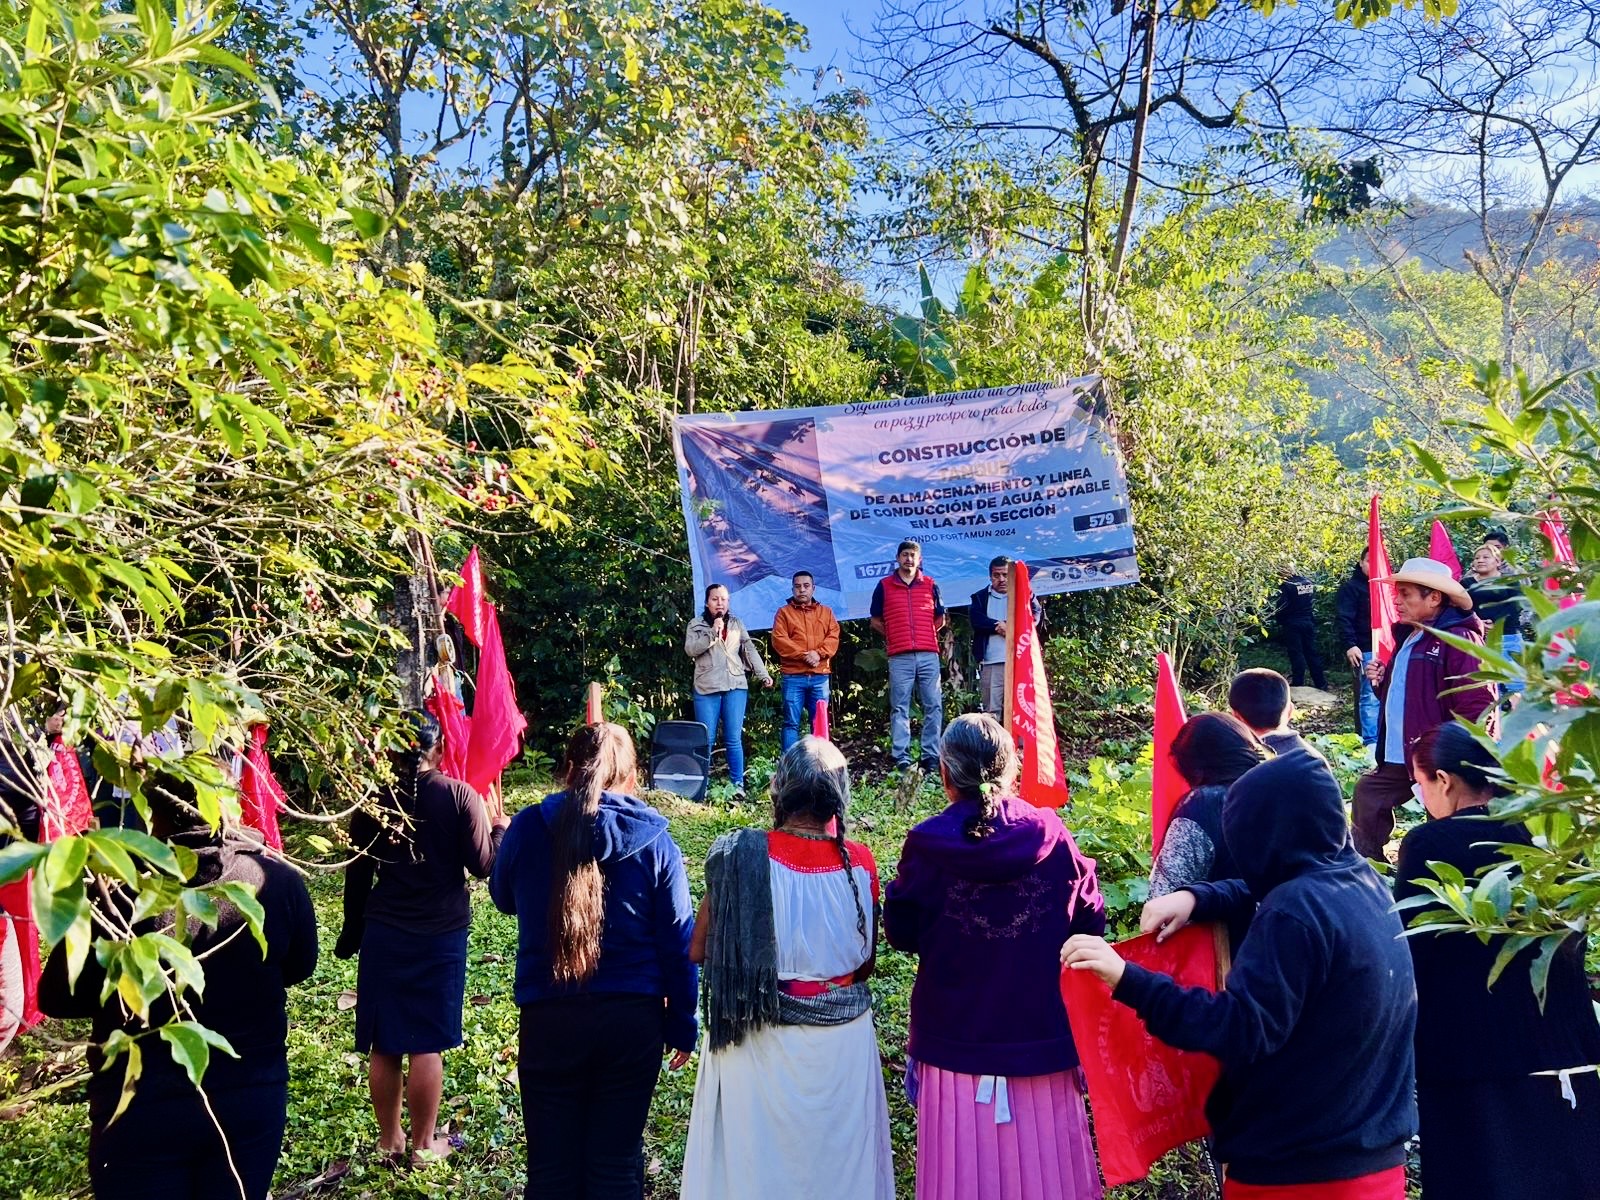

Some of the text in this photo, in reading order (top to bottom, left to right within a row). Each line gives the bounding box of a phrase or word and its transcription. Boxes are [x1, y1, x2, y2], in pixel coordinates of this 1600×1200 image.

[988, 387, 1003, 397] un
[874, 419, 890, 429] en
[889, 416, 914, 432] paz
[925, 409, 980, 428] prospero
[981, 404, 1014, 421] para
[1016, 398, 1048, 413] todos
[878, 427, 1066, 465] CONSTRUCCIÓN DE
[939, 460, 1012, 481] TANQUE
[864, 467, 1092, 506] DE ALMACENAMIENTO Y LINEA
[850, 479, 1111, 521] DE CONDUCCIÓN DE AGUA POTABLE
[910, 503, 1056, 529] EN LA 4TA SECCIÓN
[1089, 512, 1115, 528] 579
[904, 528, 1017, 544] FONDO FORTAMUN 2024
[859, 563, 892, 577] 1677
